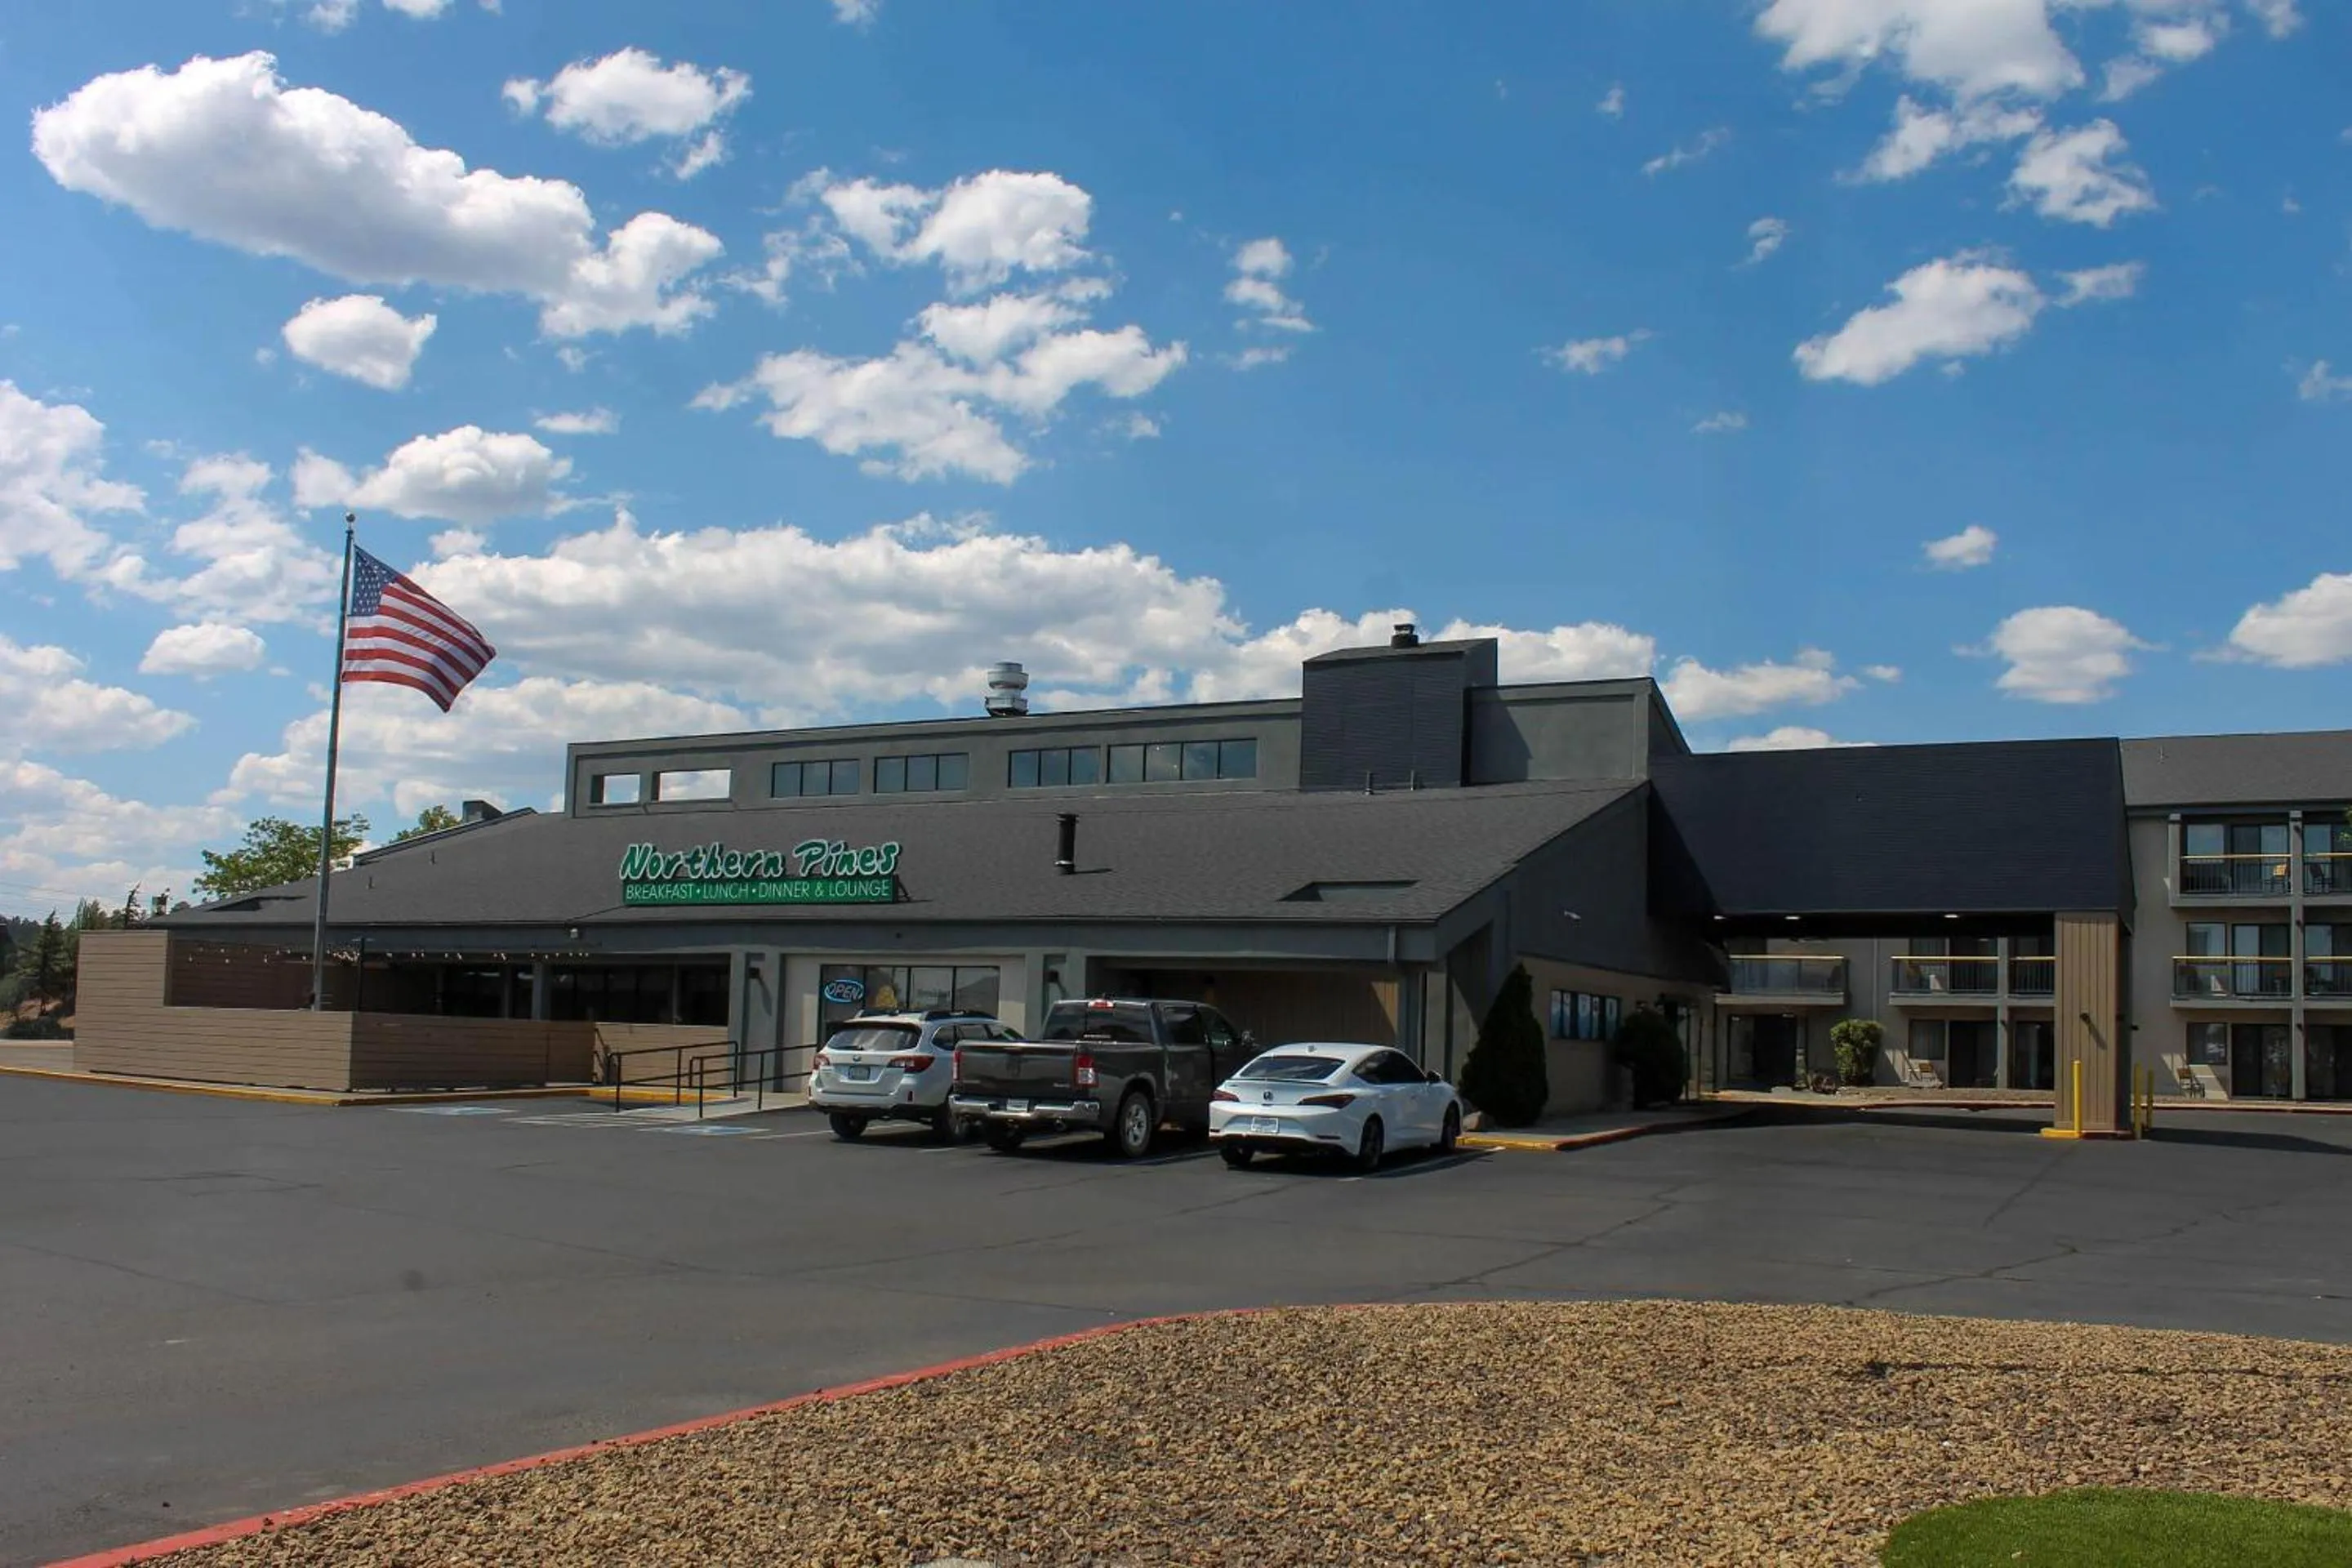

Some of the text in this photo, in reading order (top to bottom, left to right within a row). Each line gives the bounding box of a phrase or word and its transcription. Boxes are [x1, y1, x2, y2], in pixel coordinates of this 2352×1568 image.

[619, 839, 900, 880] Northern Pines
[626, 879, 889, 899] BREAKFAST LUNCH DINNER & LOUNGE
[827, 982, 860, 1000] OPEN
